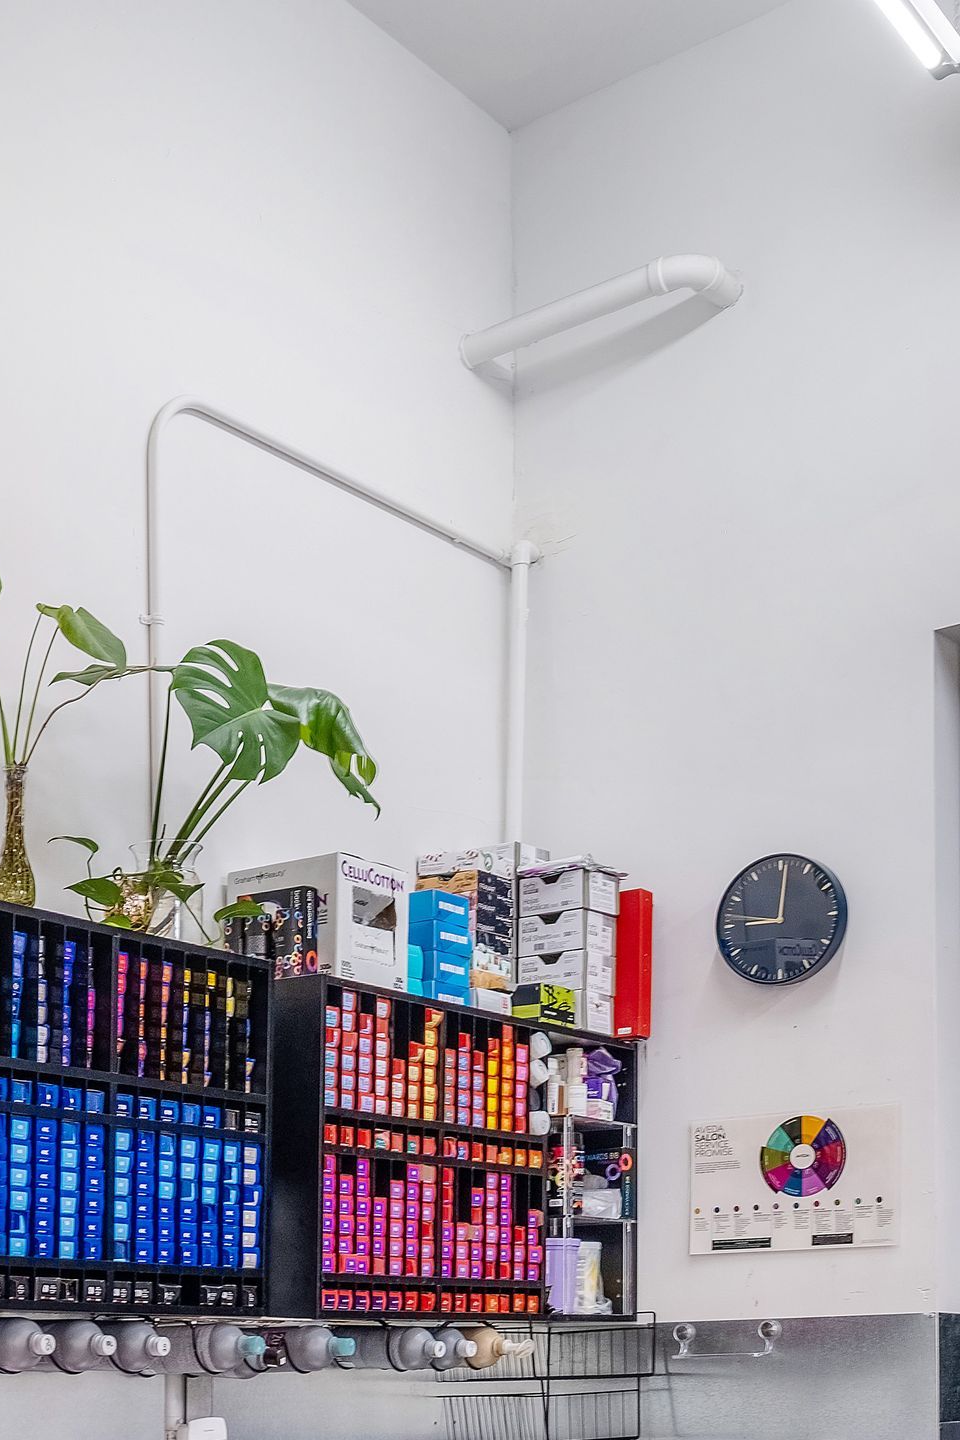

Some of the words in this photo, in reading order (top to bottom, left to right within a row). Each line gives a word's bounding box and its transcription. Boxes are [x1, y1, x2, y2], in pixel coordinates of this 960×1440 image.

[695, 1125, 724, 1134] AVEDA
[695, 1133, 726, 1142] SALON
[695, 1140, 729, 1150] SERVICE
[695, 1148, 733, 1157] PROMISE
